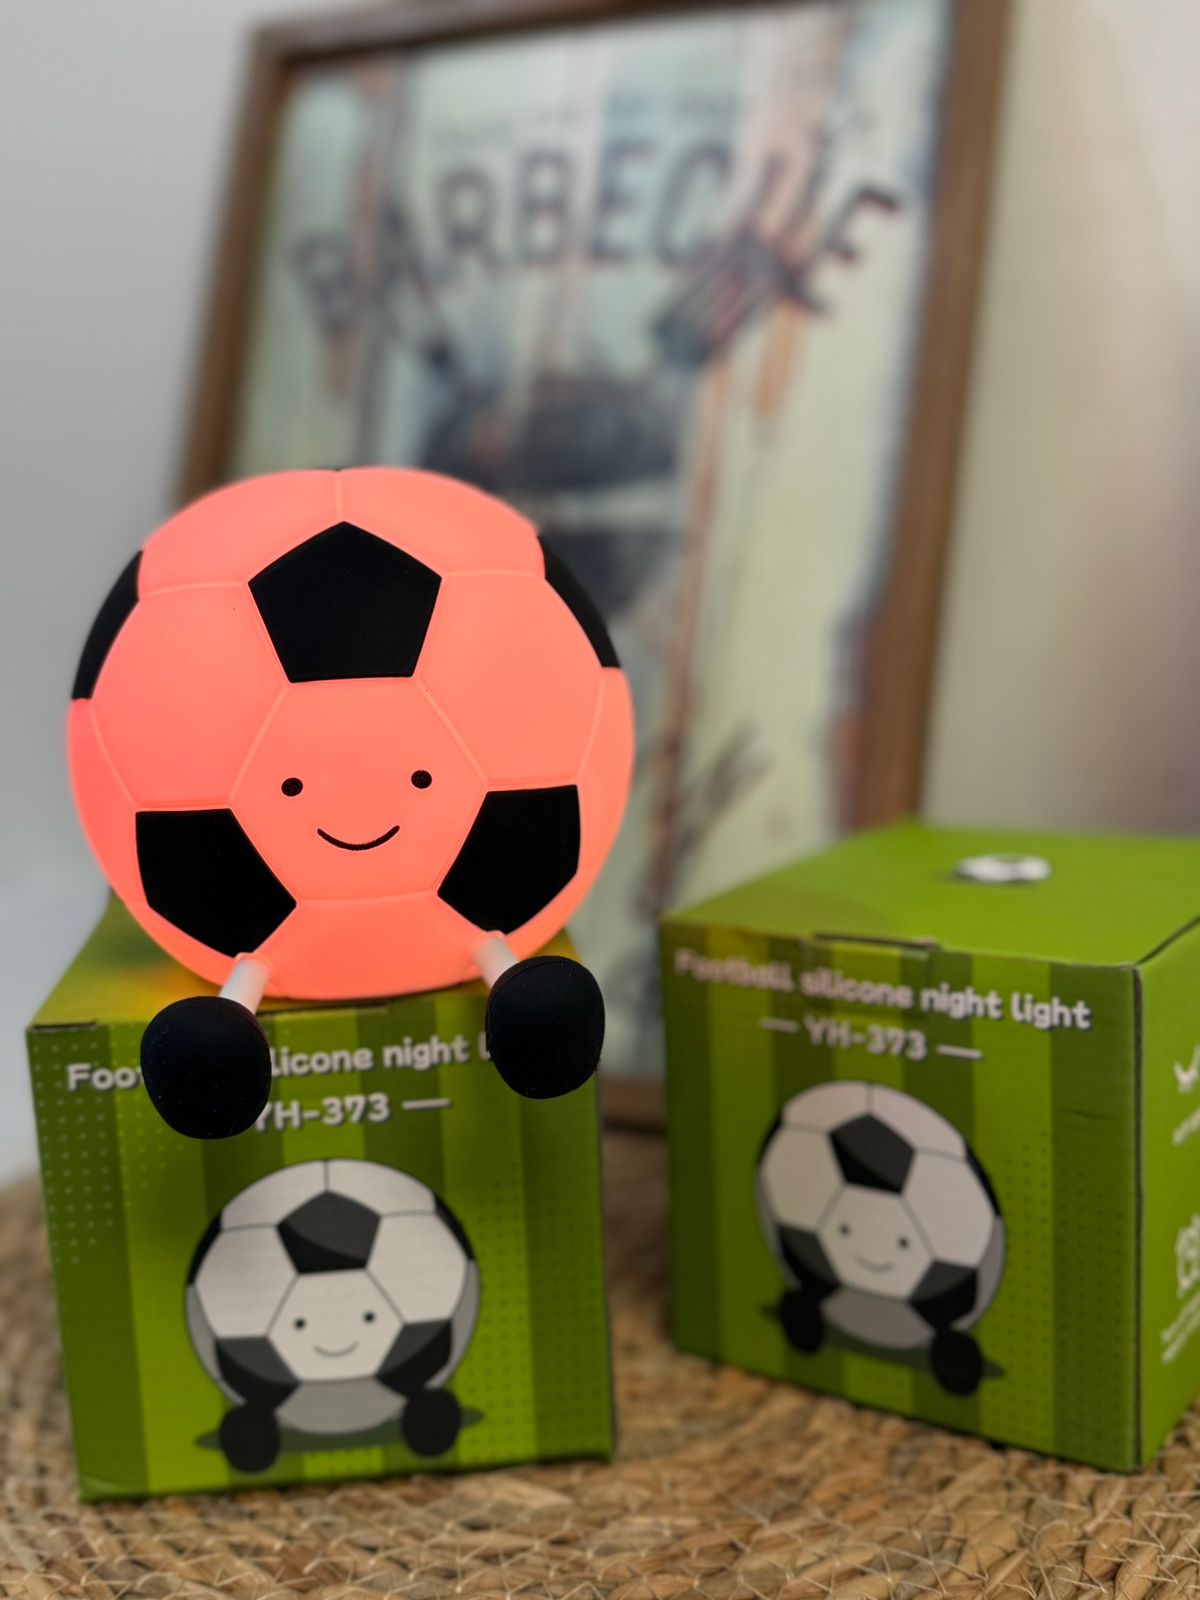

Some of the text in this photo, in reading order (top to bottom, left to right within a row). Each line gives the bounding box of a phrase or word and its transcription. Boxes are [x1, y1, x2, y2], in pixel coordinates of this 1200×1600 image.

[674, 949, 1092, 1031] Football silicone night light
[269, 1046, 373, 1078] licone
[382, 1031, 471, 1072] night
[805, 1014, 928, 1062] YH-373
